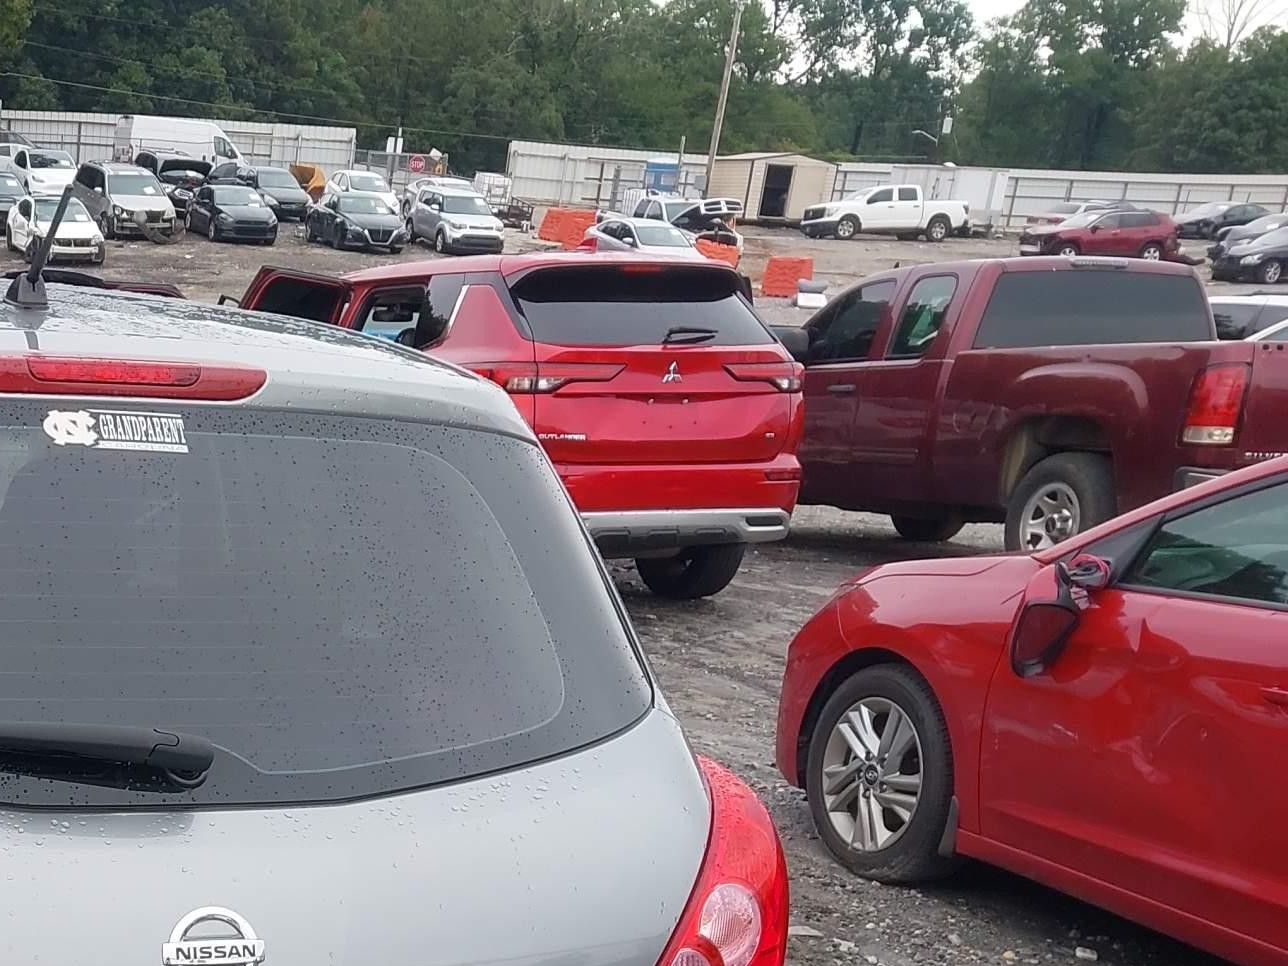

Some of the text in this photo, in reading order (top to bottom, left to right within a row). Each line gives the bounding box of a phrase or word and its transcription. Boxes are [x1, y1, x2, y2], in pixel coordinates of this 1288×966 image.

[412, 160, 424, 169] STOP
[99, 414, 186, 444] GRANDPARENT
[176, 944, 256, 960] NISSAN
